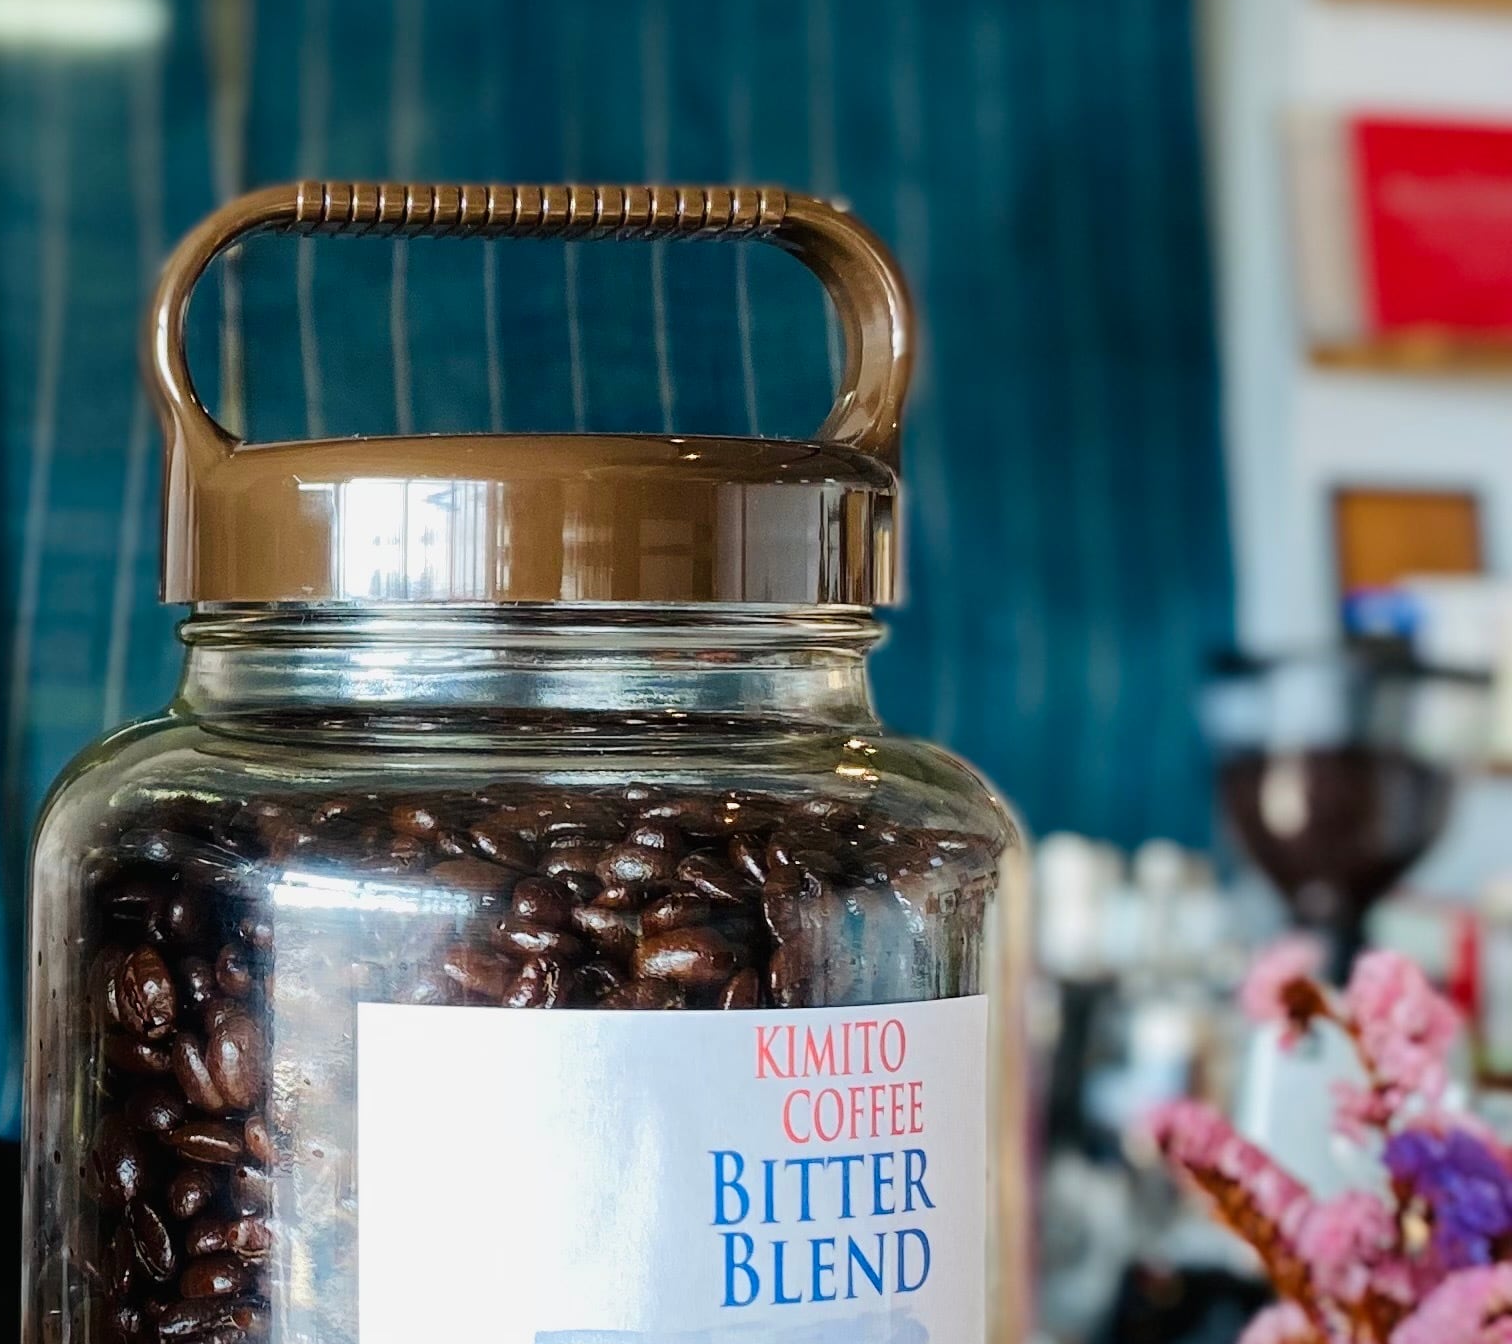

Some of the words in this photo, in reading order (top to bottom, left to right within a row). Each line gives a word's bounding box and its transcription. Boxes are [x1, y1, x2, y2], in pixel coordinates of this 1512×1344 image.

[754, 1018, 907, 1079] KIMITO
[783, 1081, 925, 1144] COFFEE
[708, 1148, 937, 1226] BITTER
[719, 1228, 931, 1308] BLEND
